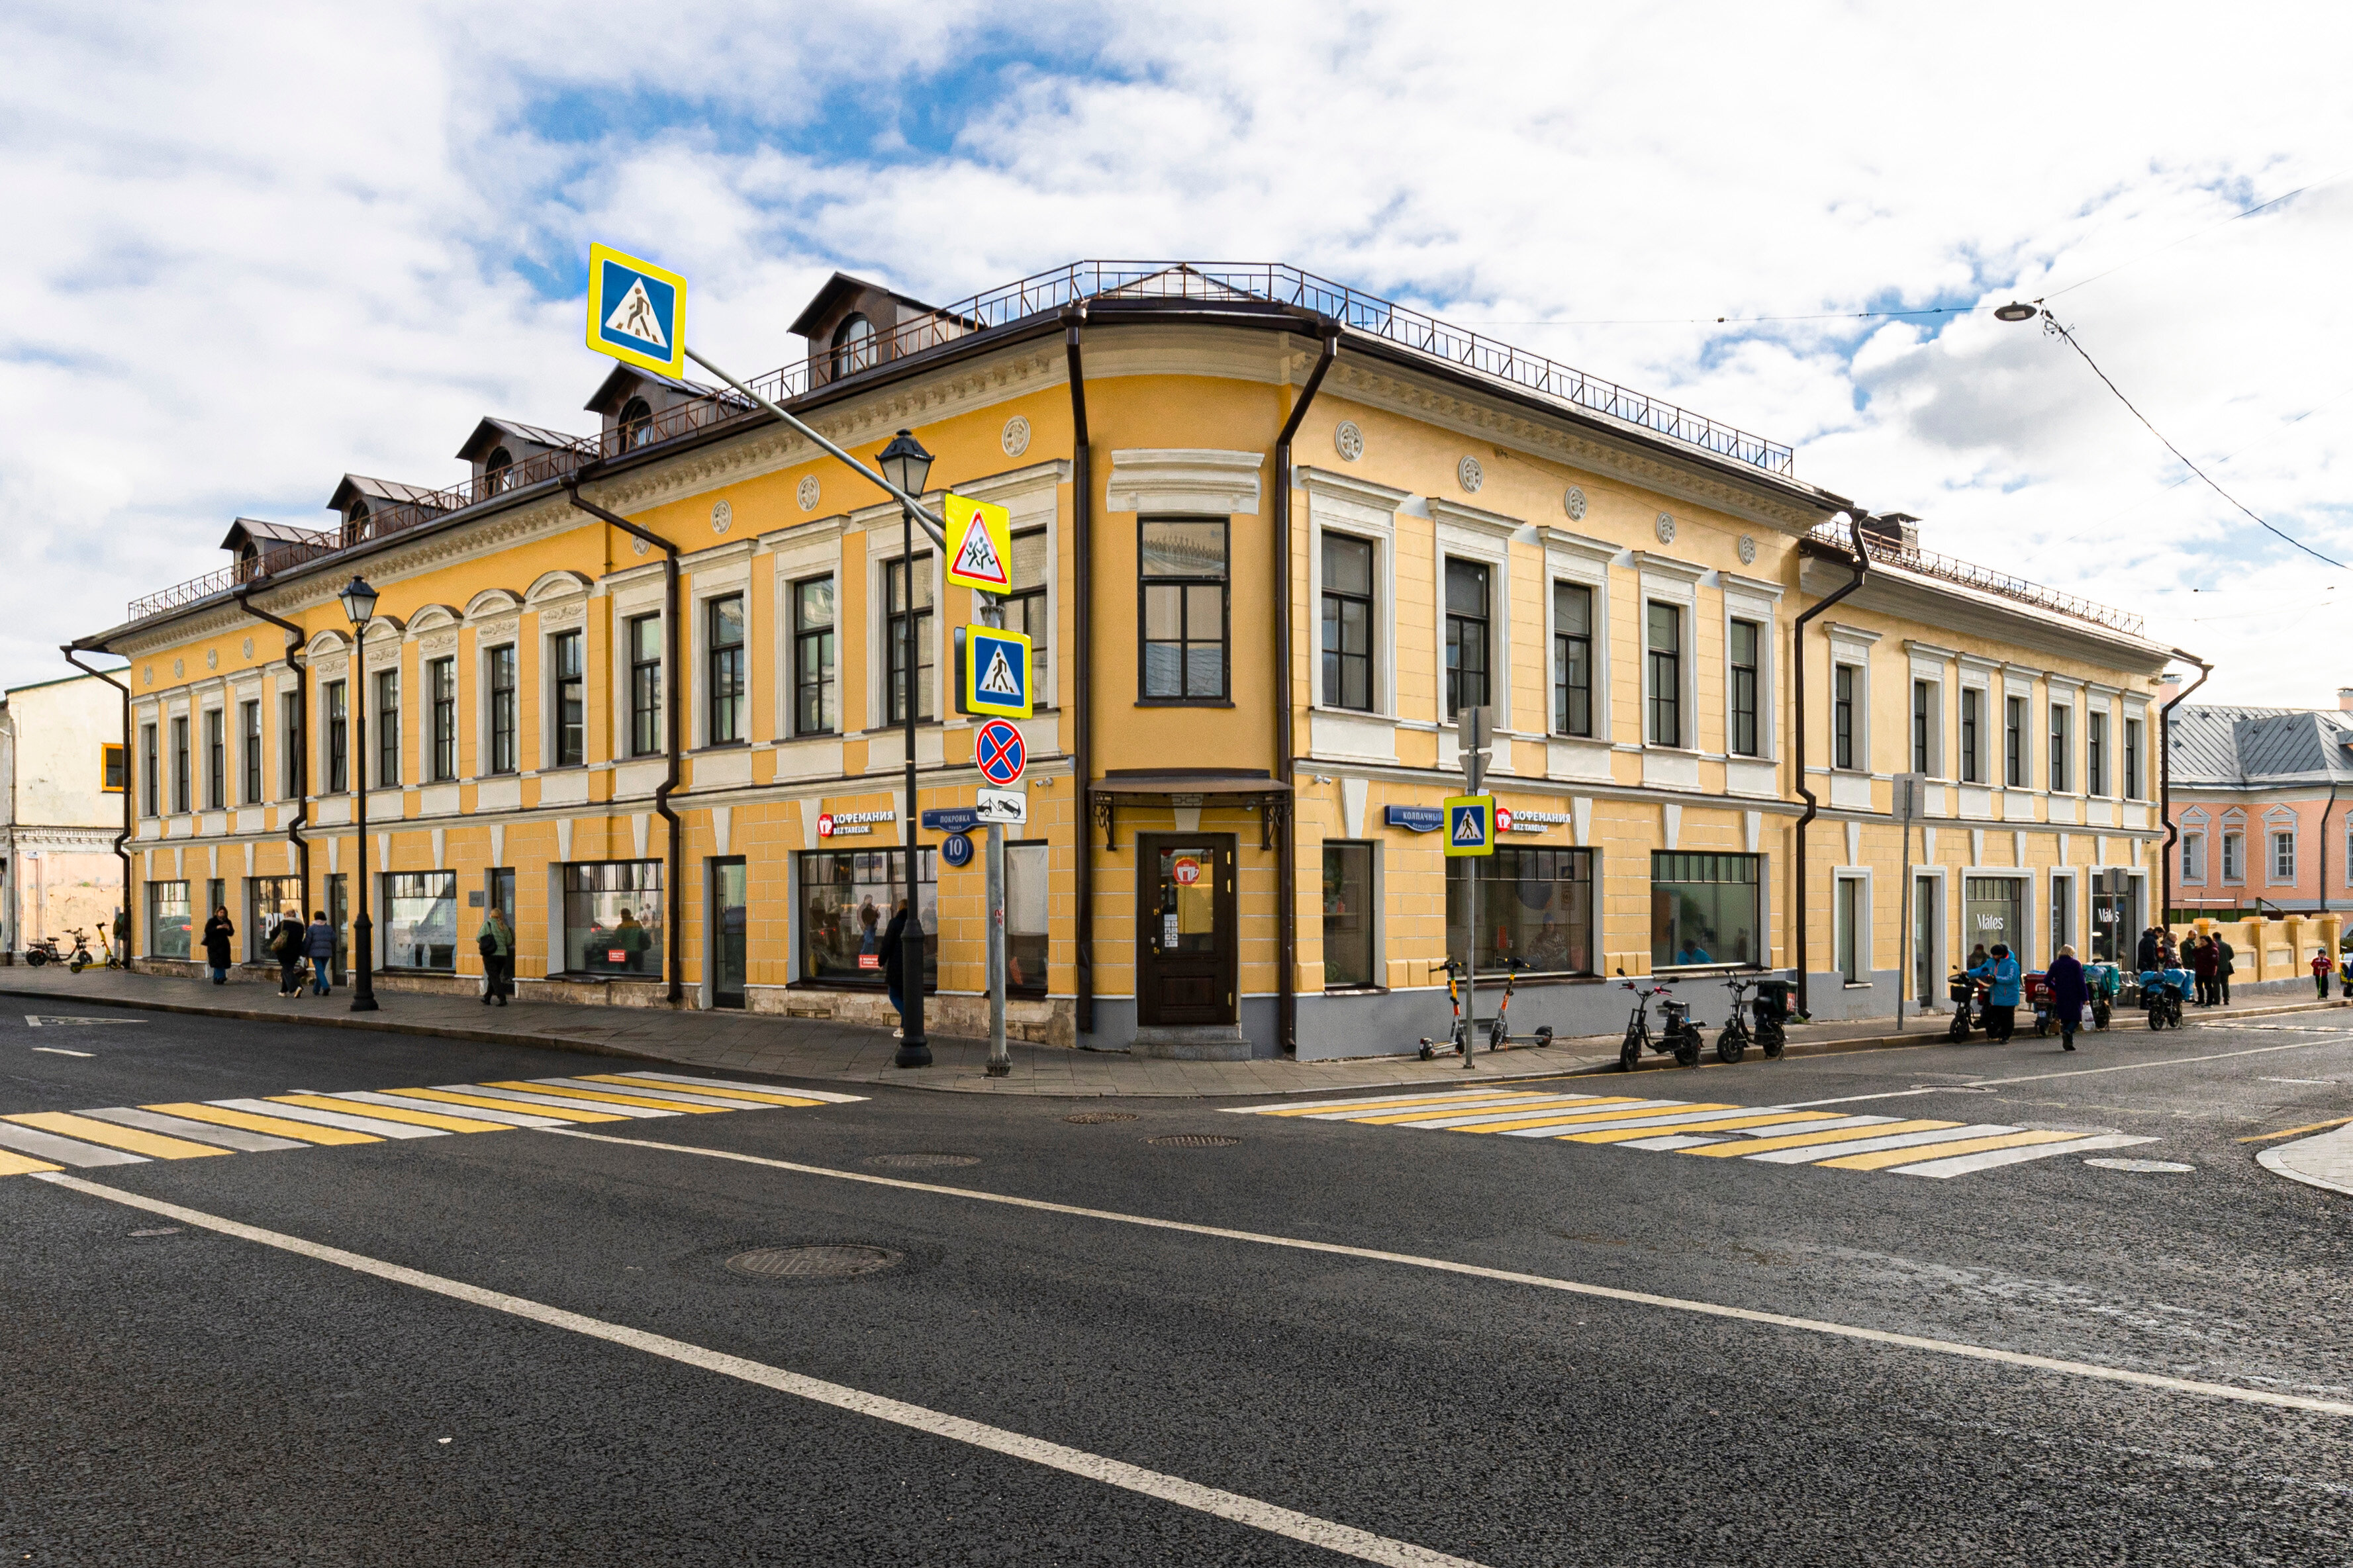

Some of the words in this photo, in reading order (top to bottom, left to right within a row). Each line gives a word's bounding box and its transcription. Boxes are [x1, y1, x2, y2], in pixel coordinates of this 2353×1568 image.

[834, 811, 892, 824] КОФЕМАНИЯ
[940, 815, 971, 823] ПОКРОВКА
[1403, 811, 1443, 821] КОЛПАЧНЫЙ
[1513, 811, 1571, 823] КОФЕМАНИЯ
[948, 838, 963, 856] 10
